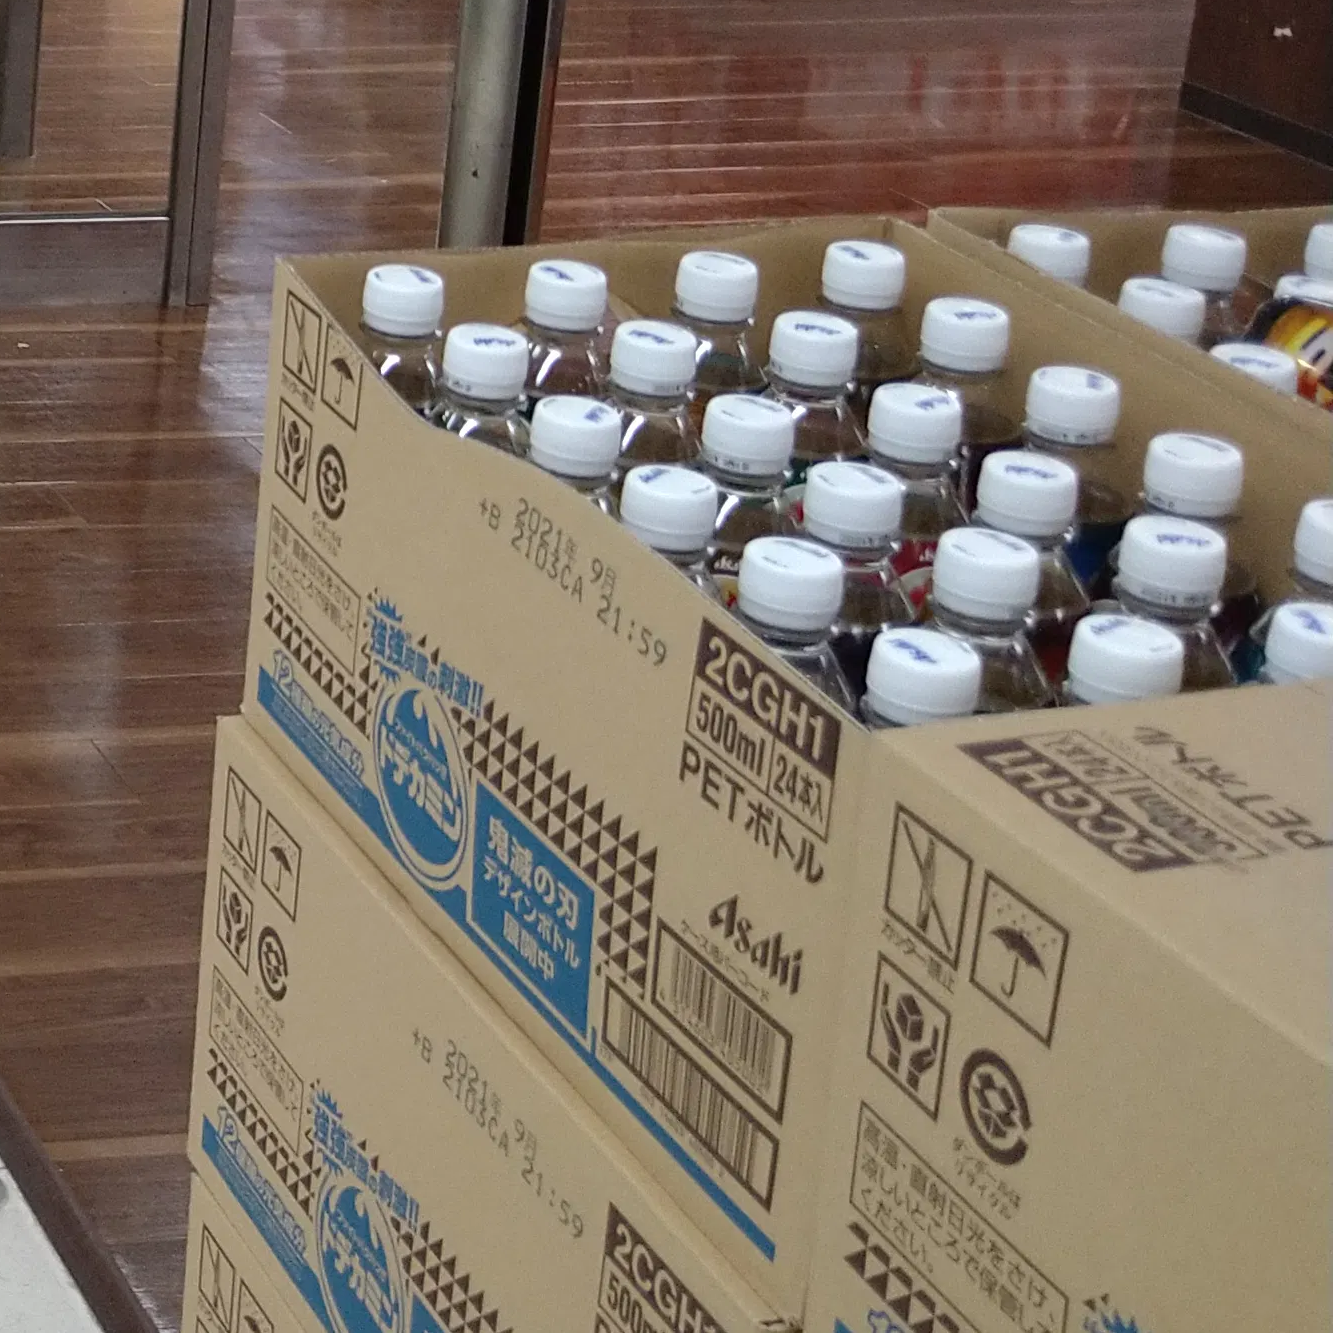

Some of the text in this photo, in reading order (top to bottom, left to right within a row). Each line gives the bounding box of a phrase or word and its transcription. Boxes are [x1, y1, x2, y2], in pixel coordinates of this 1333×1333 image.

[596, 593, 667, 667] 21:59
[704, 635, 825, 762] 2CGH1
[380, 723, 462, 843] ドデカミン
[678, 738, 825, 884] PETボトル
[695, 691, 823, 824] 500ml 24本入
[983, 747, 1175, 863] 2CGH1
[484, 855, 580, 969] デザインボトル
[487, 814, 580, 931] 鬼滅の刃
[709, 893, 803, 996] Asahi
[520, 1160, 584, 1239] 21:59
[613, 1222, 718, 1333] 2CGH
